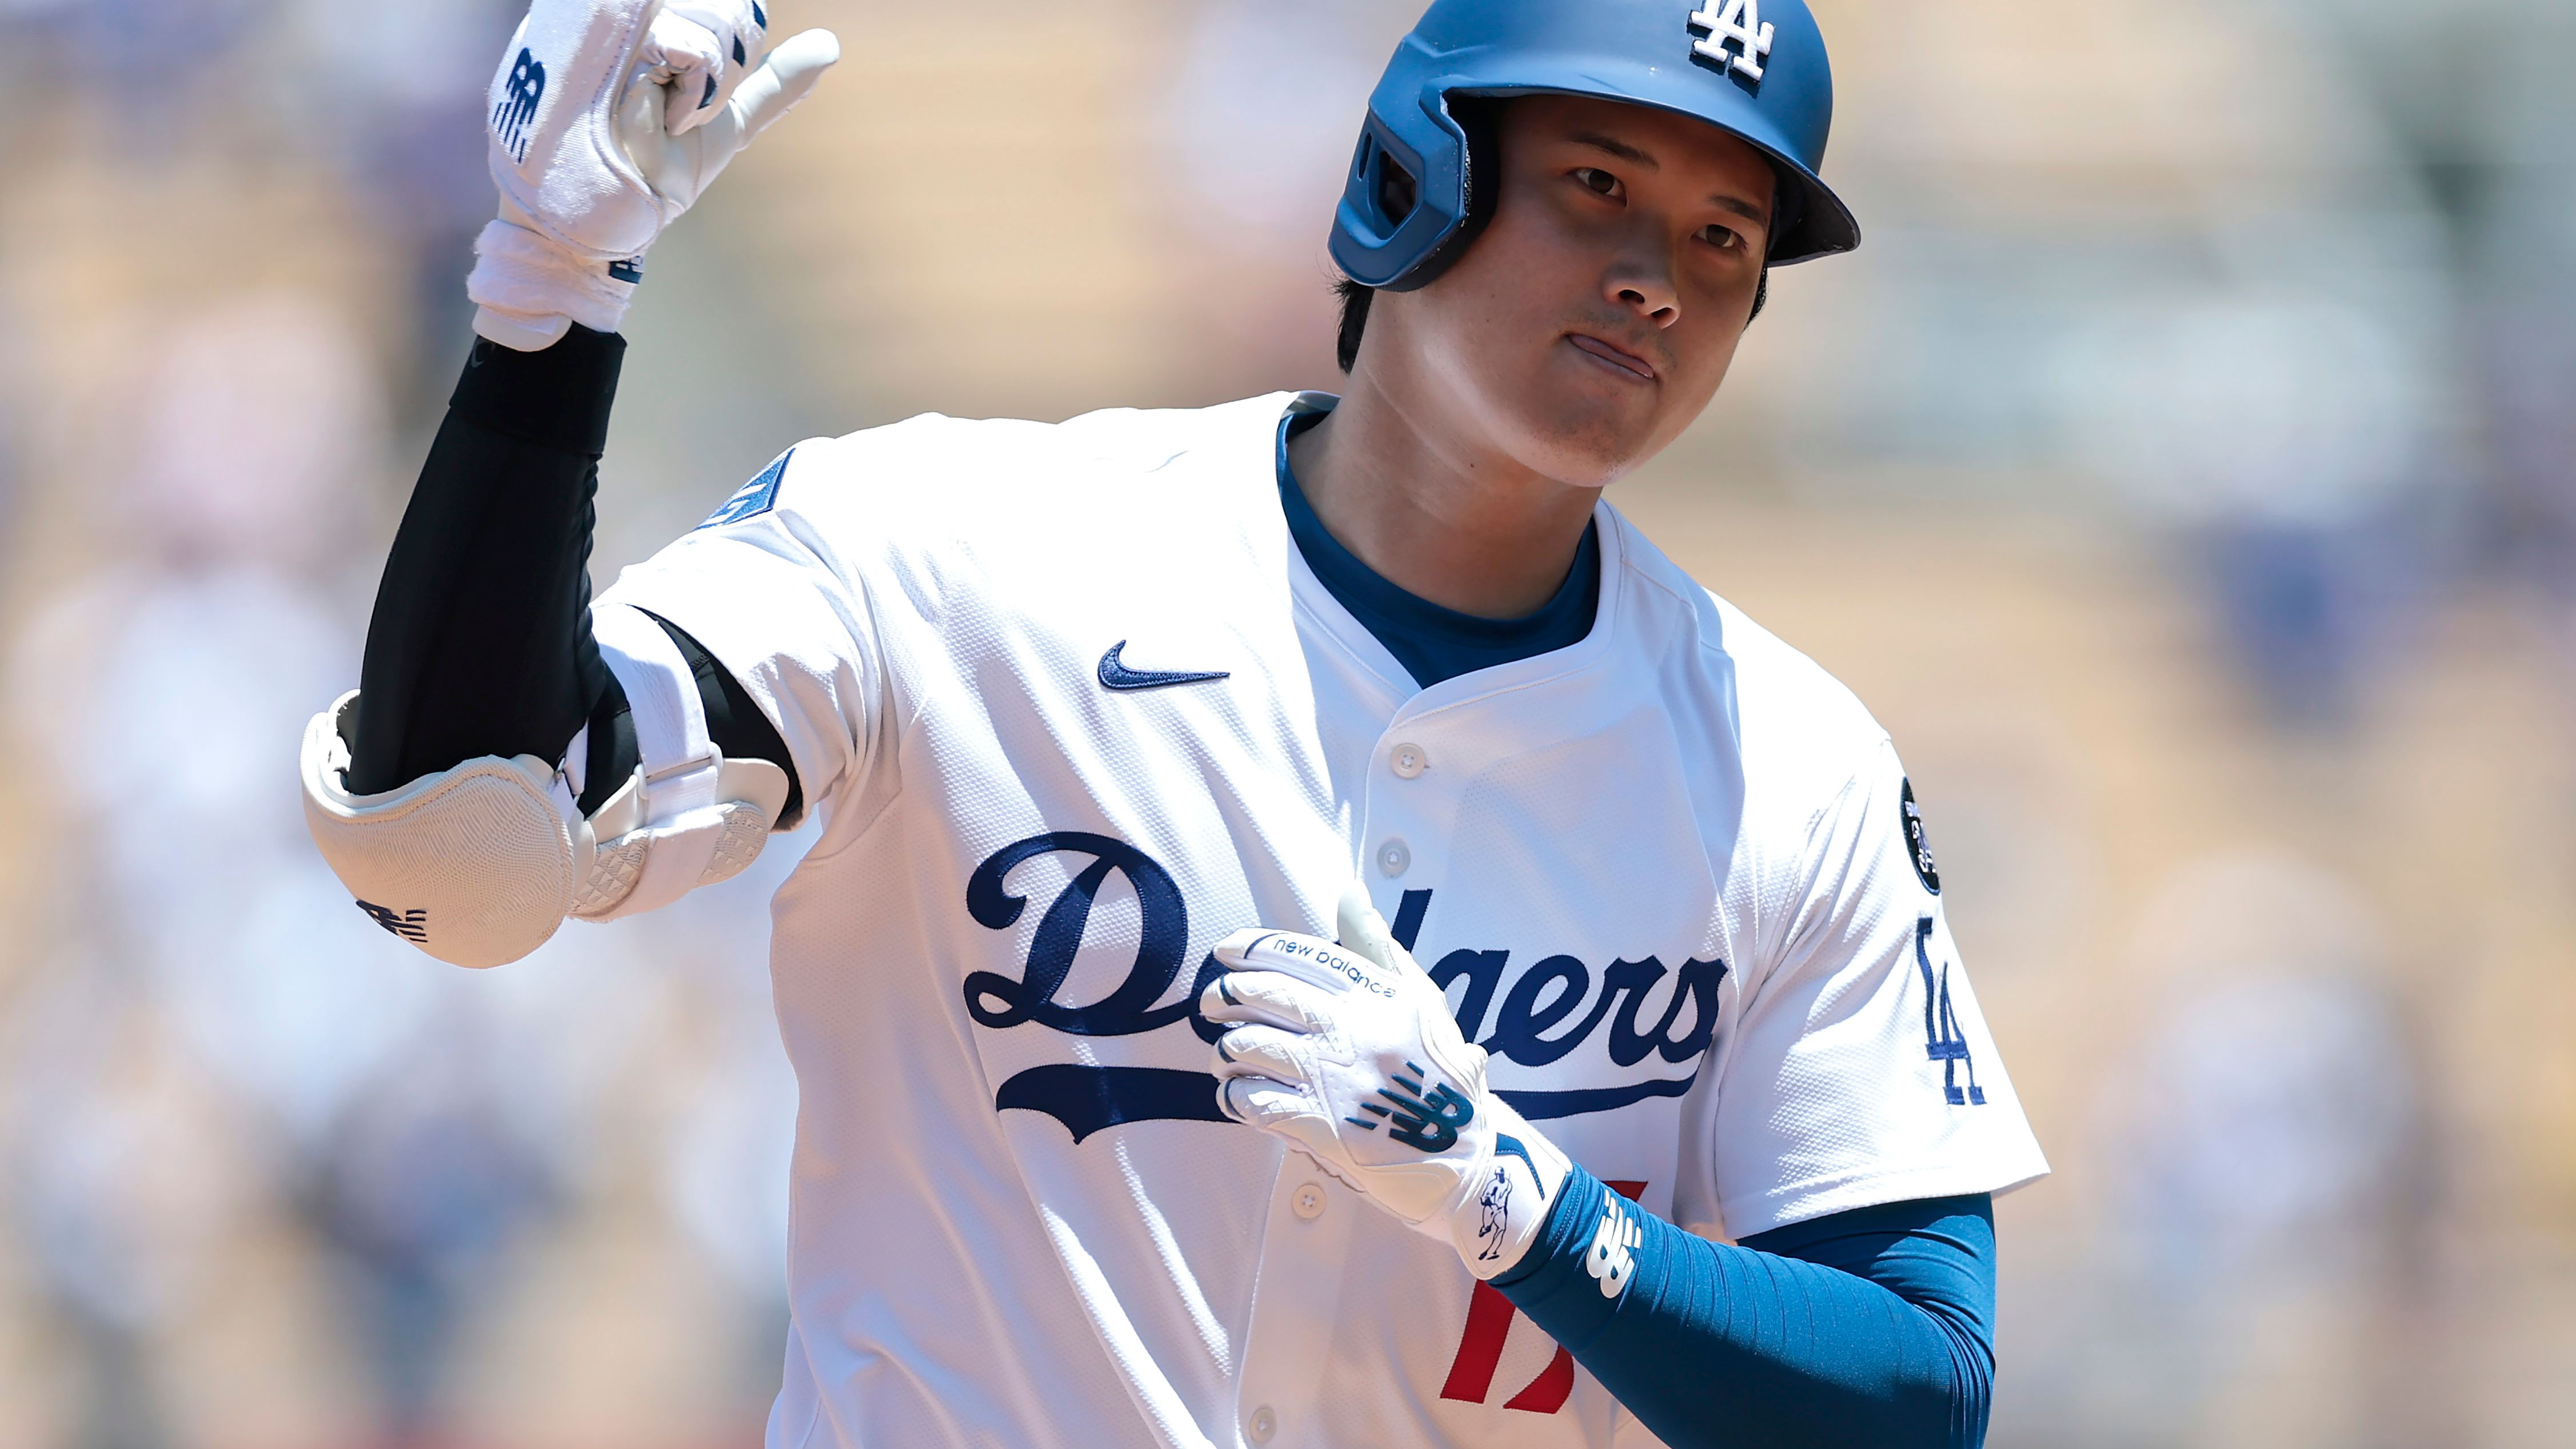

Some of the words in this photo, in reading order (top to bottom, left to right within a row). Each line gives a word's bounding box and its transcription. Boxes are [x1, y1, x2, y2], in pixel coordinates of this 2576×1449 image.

[1691, 0, 1775, 81] LA
[963, 831, 1728, 1068] Dgers
[1273, 939, 1314, 957] new
[1316, 948, 1396, 997] balance
